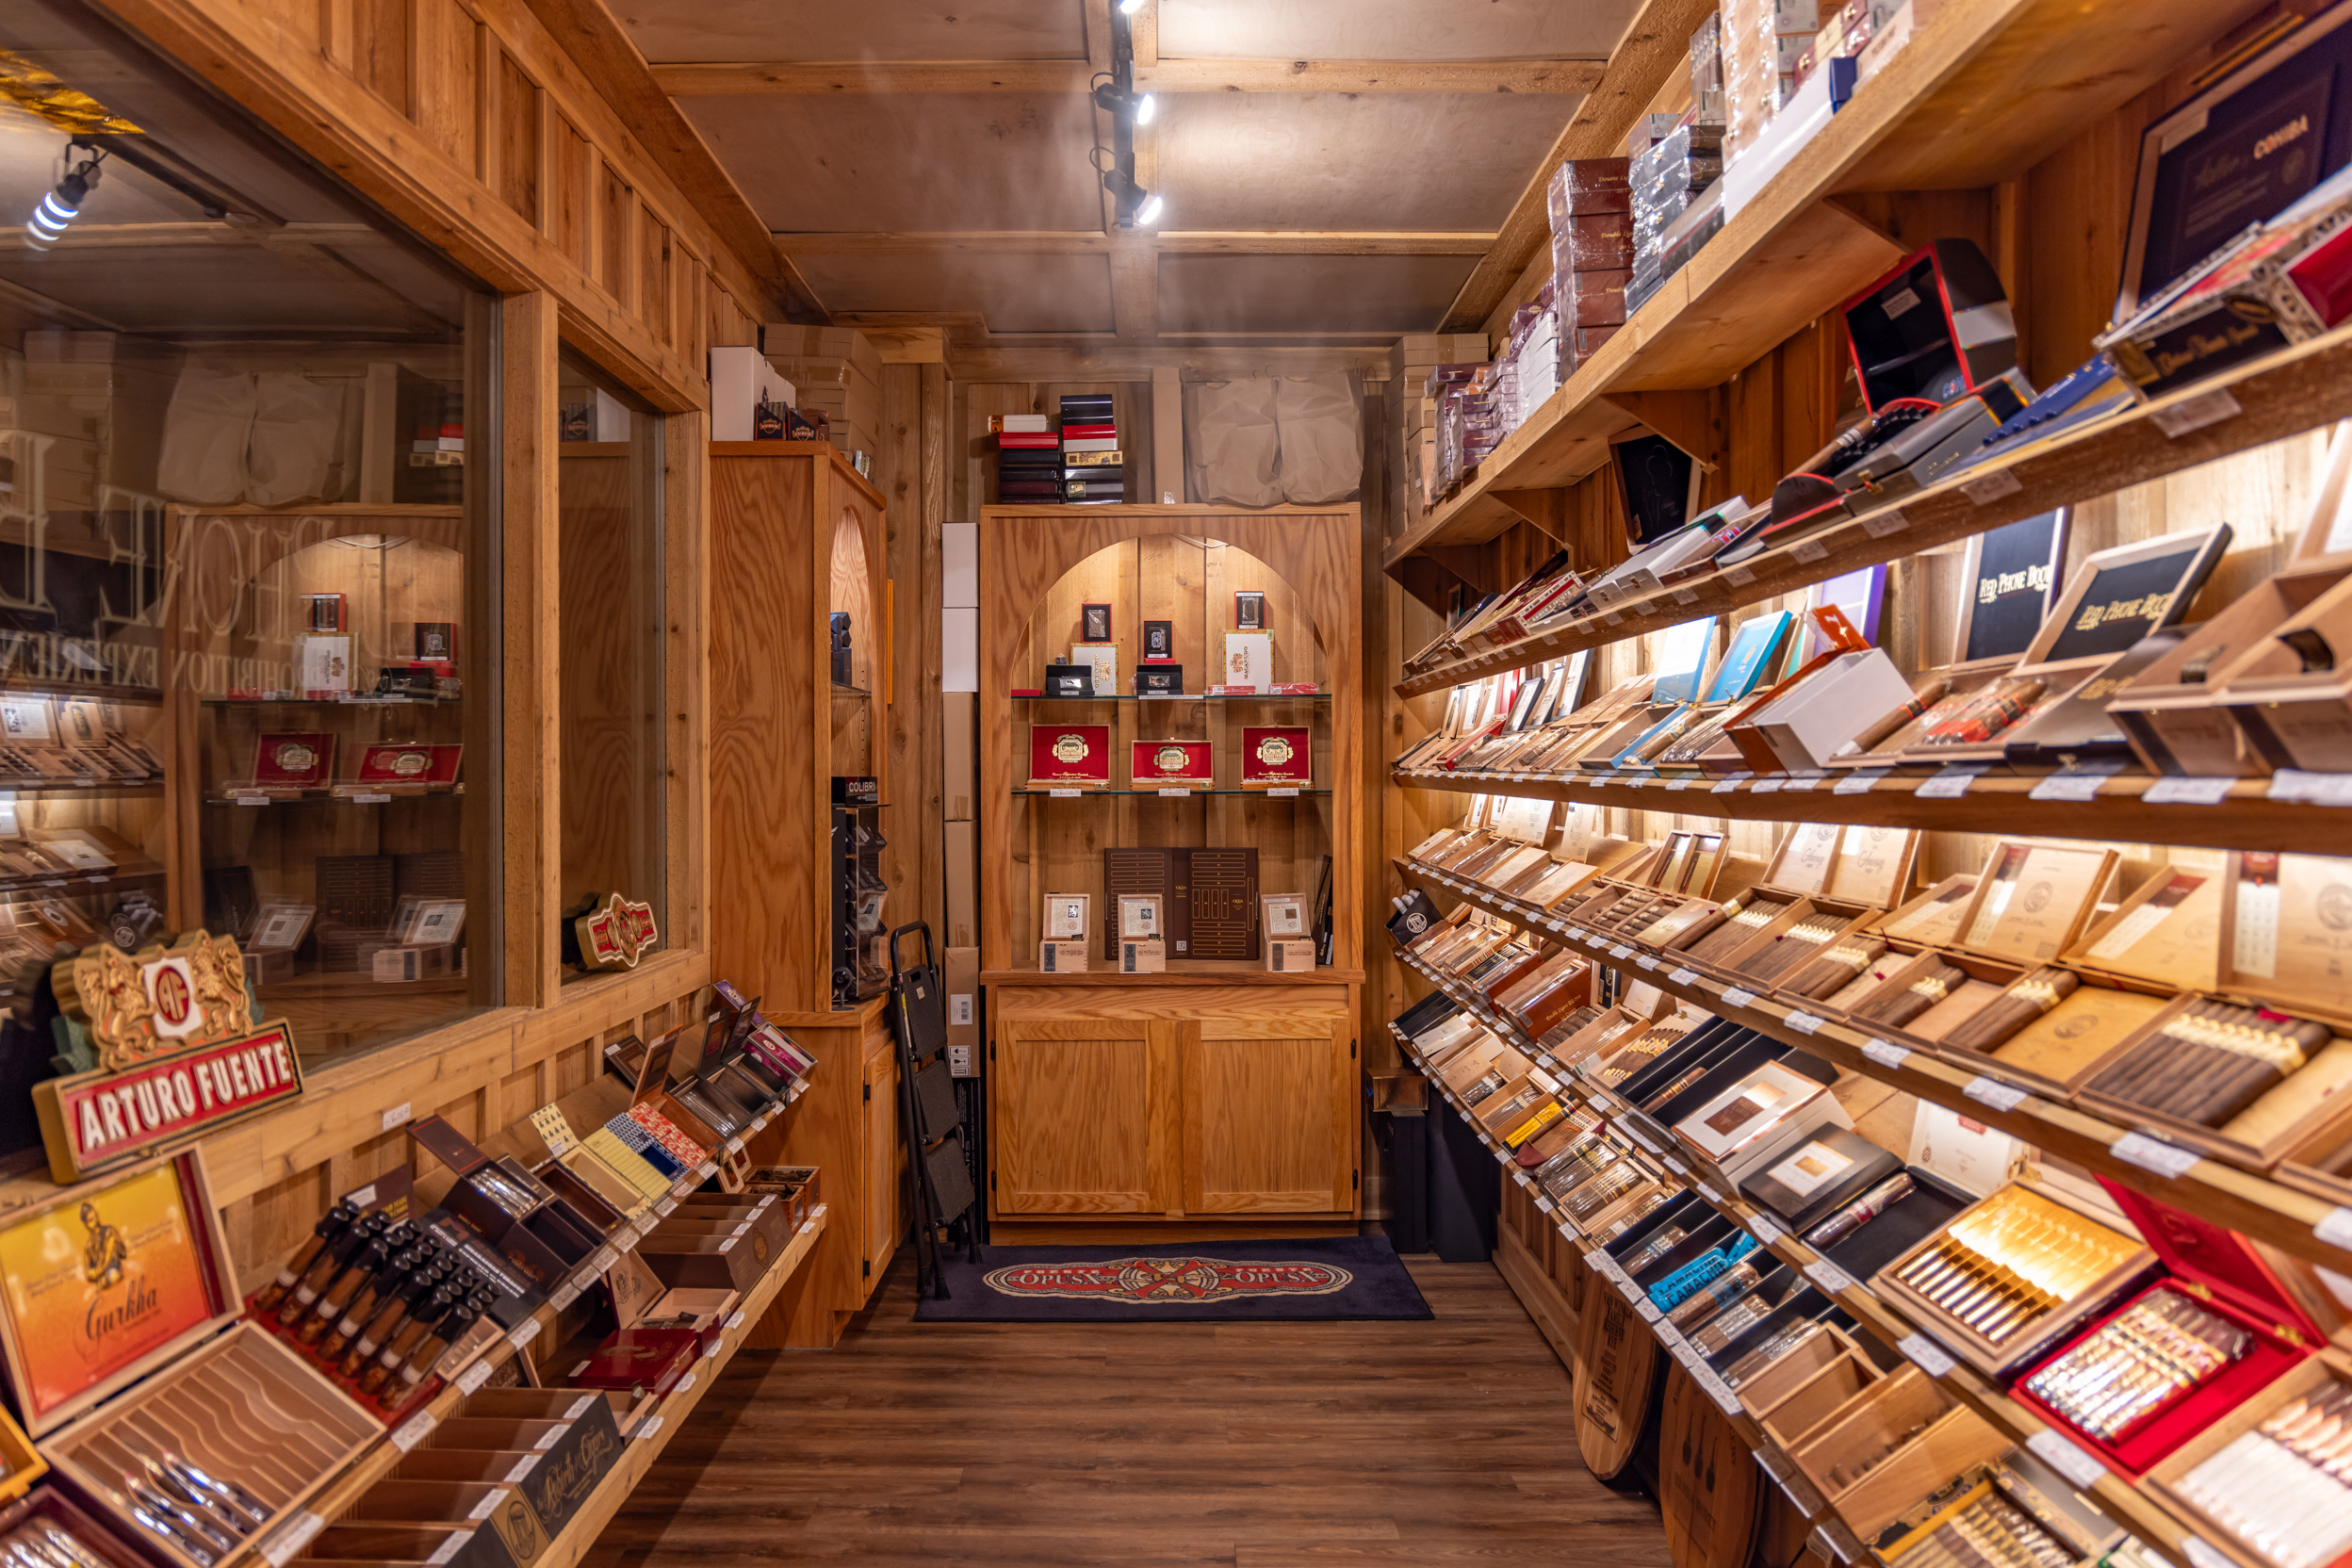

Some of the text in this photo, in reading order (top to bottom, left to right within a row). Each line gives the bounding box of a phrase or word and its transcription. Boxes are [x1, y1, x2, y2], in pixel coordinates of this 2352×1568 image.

[1942, 375, 1967, 400] COH
[849, 781, 875, 792] COLIBRI
[78, 1040, 291, 1152] ARTURO FUENTE
[85, 1274, 157, 1345] Gurkha
